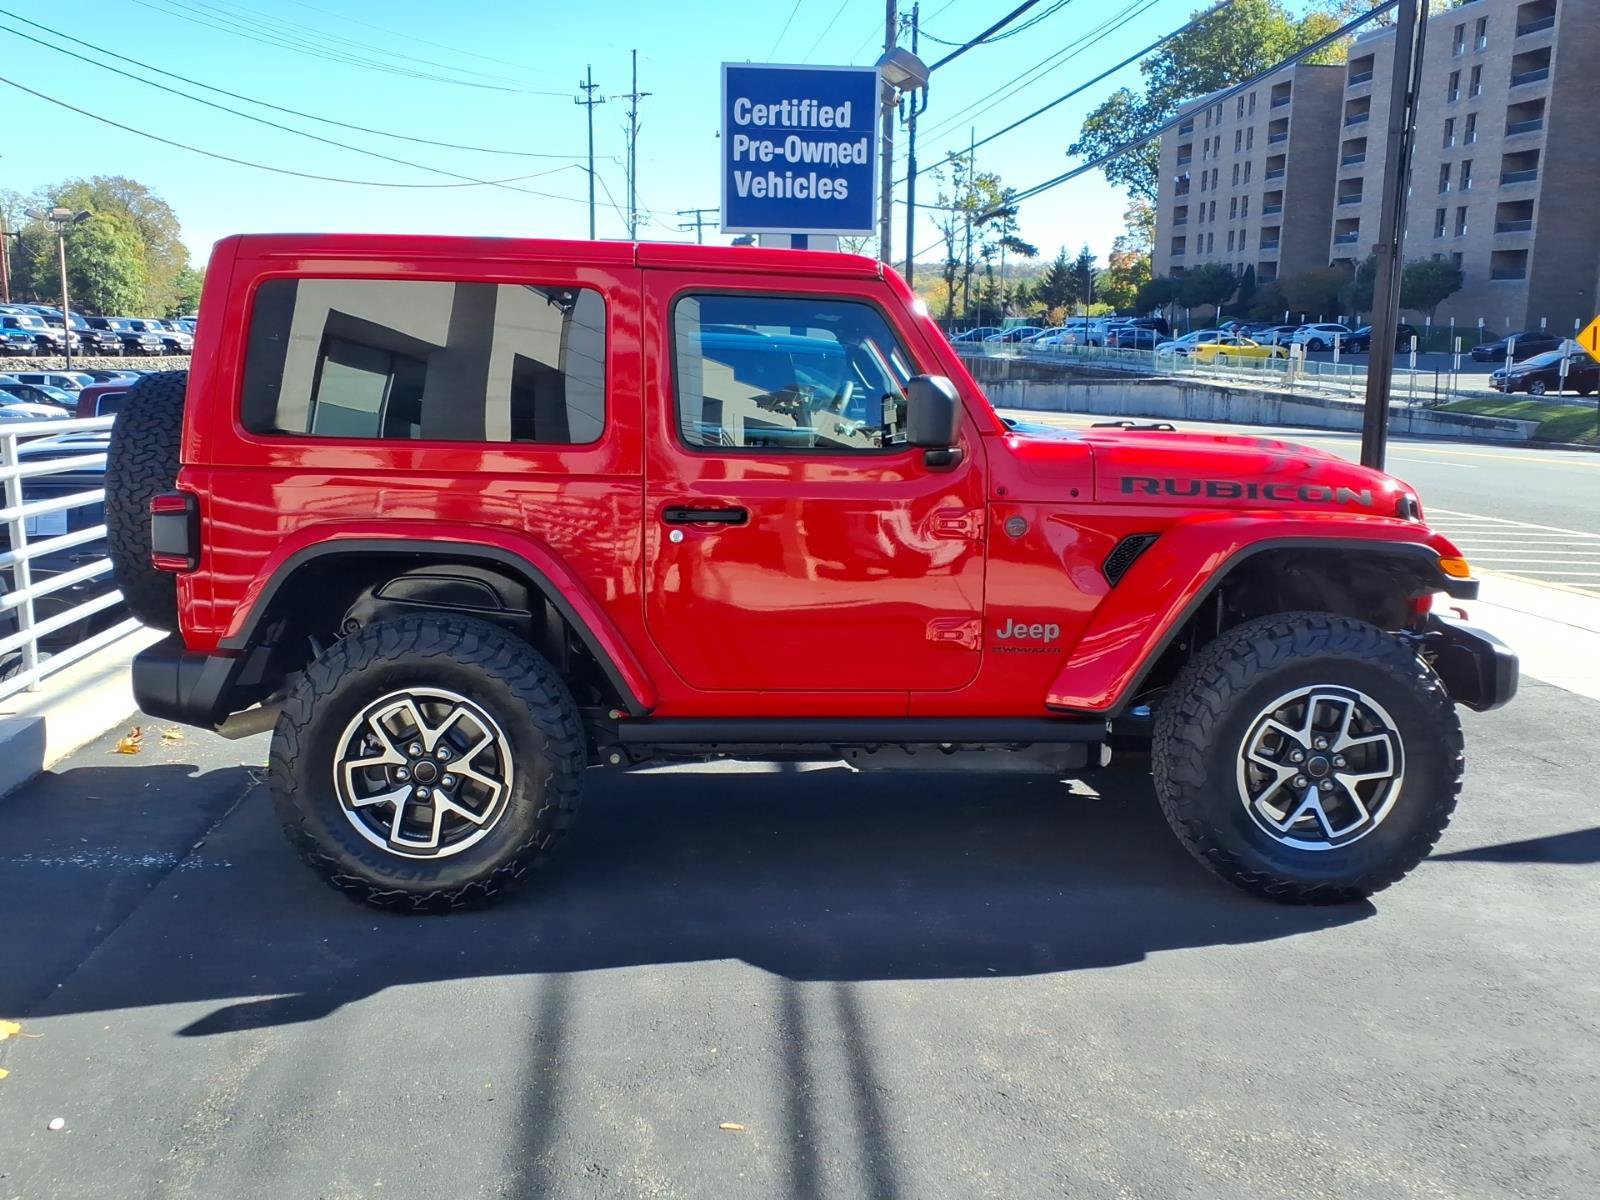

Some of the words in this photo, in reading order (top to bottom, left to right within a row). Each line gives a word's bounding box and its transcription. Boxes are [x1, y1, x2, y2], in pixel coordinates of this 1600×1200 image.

[733, 97, 852, 128] Certified
[733, 134, 868, 165] Pre-Owned
[733, 170, 849, 200] Vehicles
[1121, 475, 1373, 507] RUBICON
[996, 618, 1060, 643] Jeep
